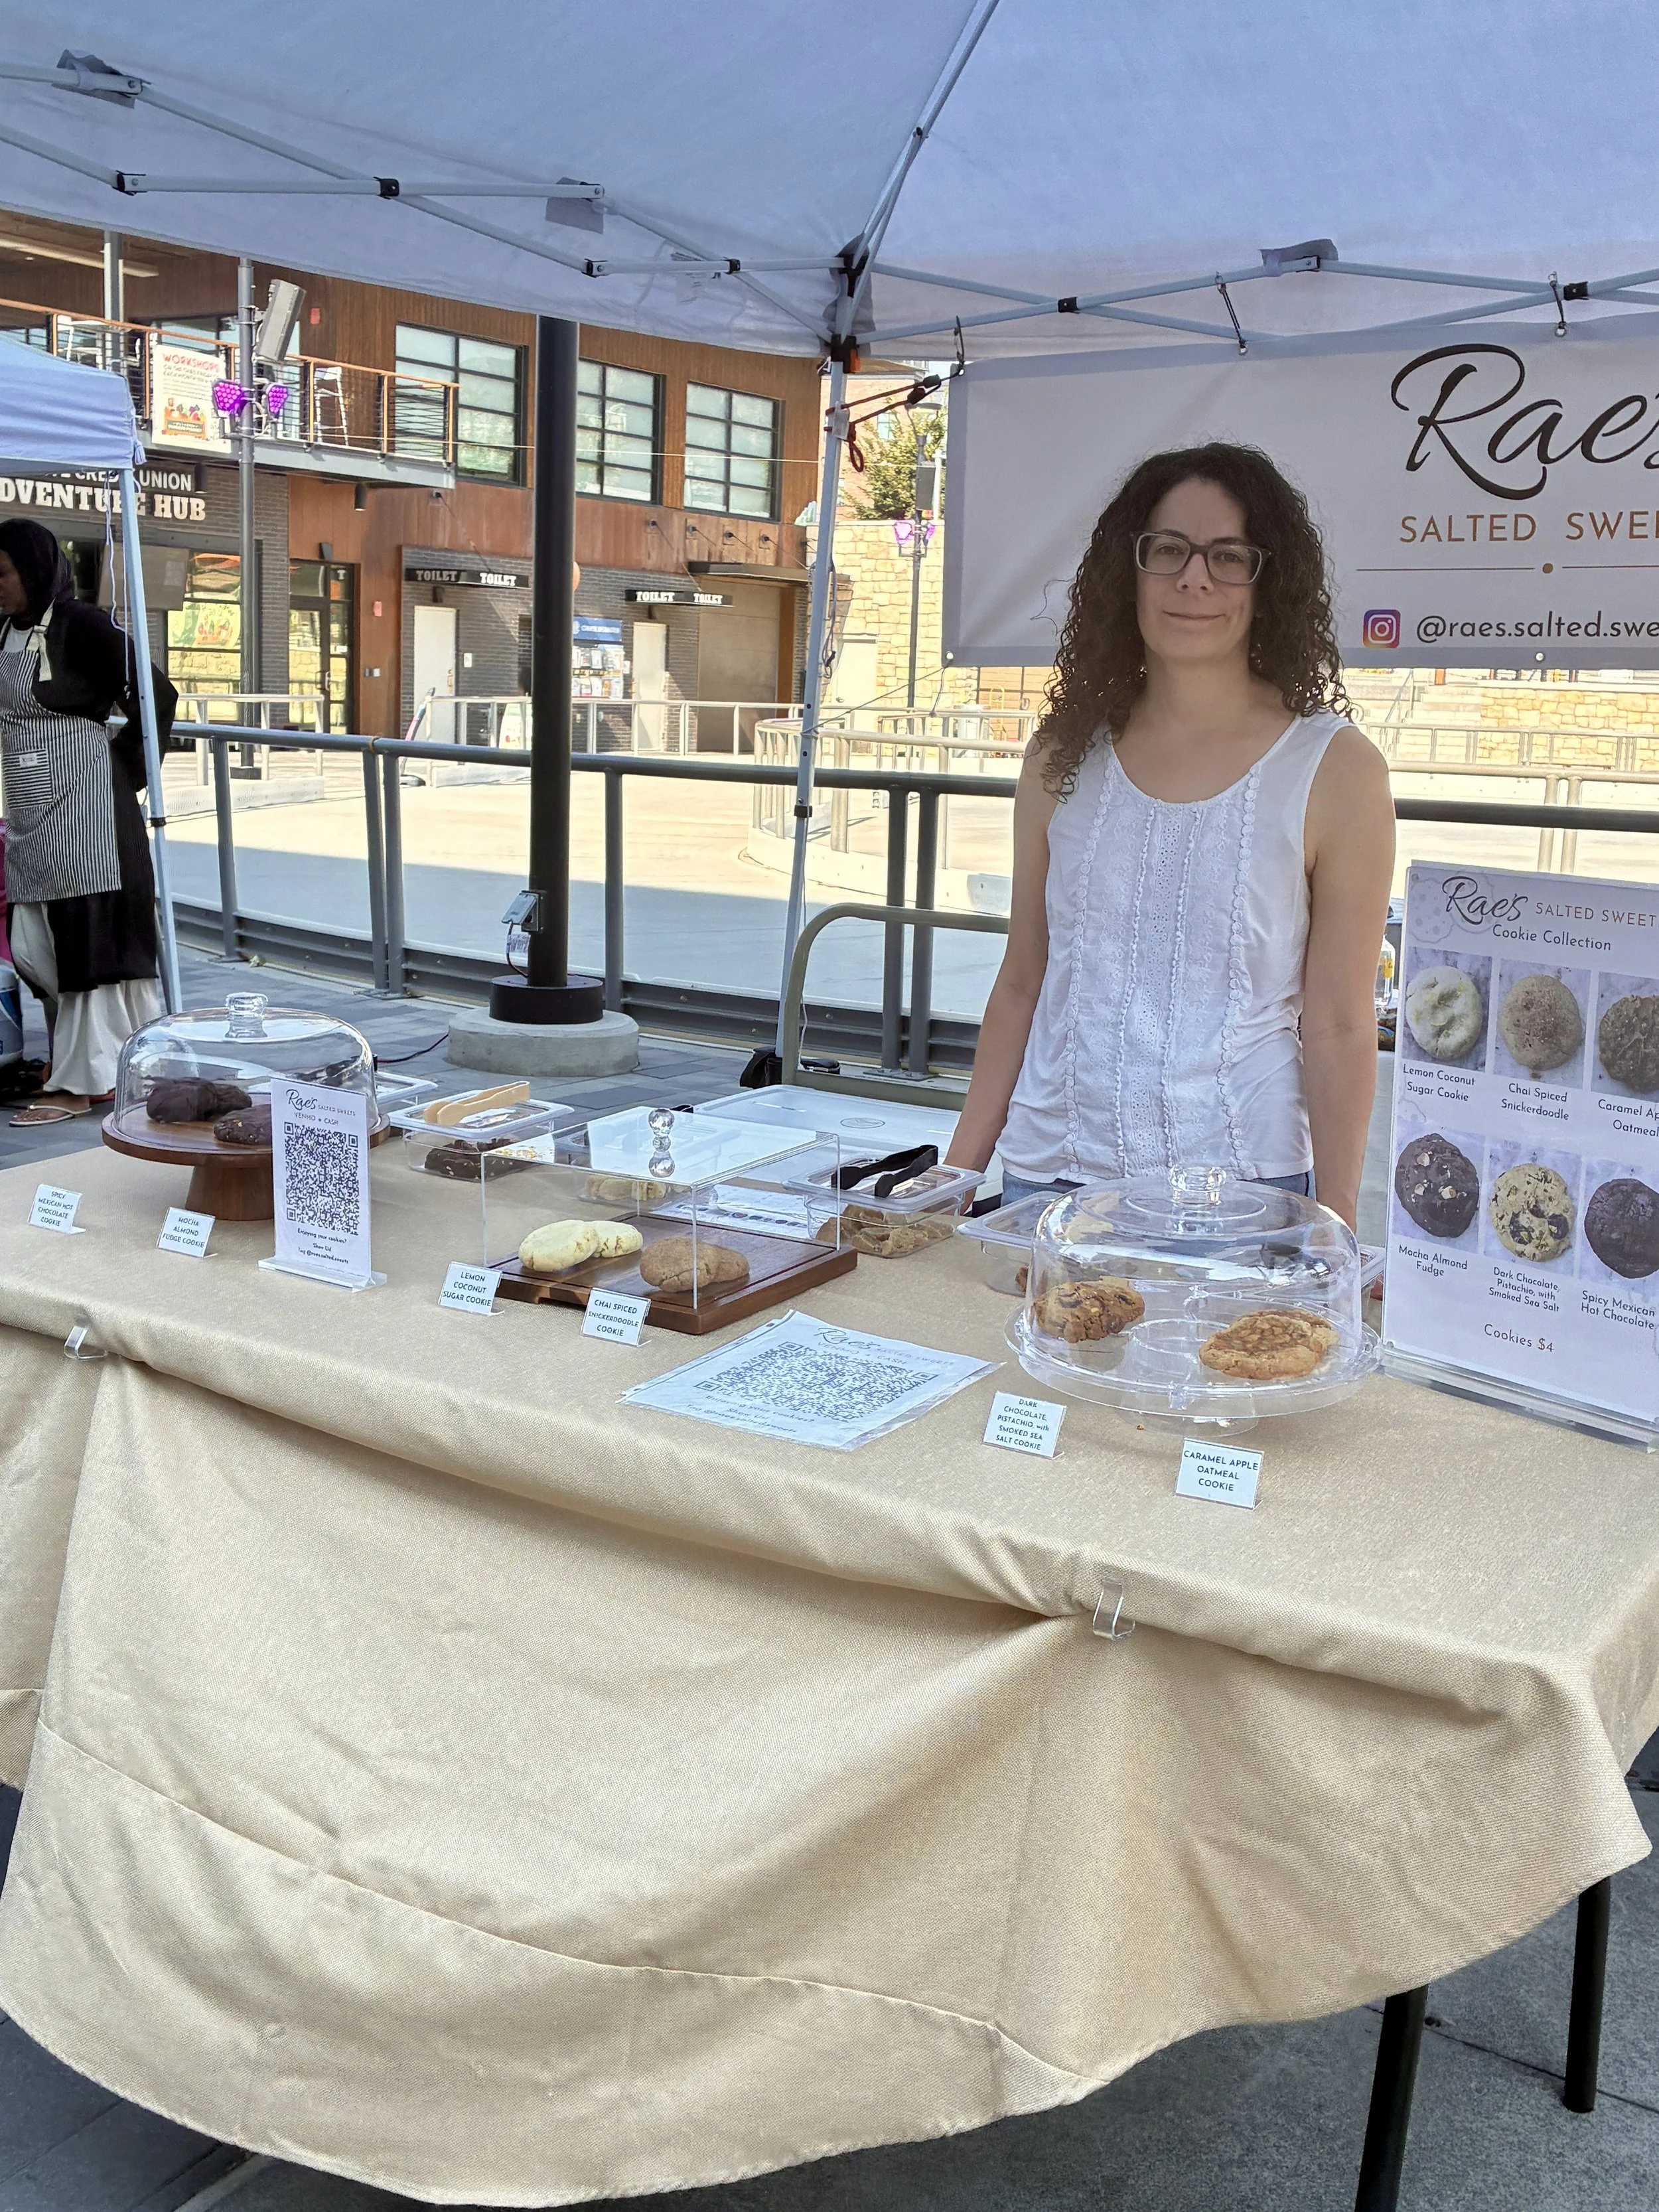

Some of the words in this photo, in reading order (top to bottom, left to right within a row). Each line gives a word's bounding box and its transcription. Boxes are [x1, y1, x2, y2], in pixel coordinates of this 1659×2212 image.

[139, 469, 191, 491] UNION
[153, 494, 206, 521] HUB
[1399, 514, 1537, 543] SALTED
[1565, 510, 1659, 540] SWE
[415, 570, 457, 581] TOILET
[479, 572, 517, 587] TOILET
[636, 591, 675, 602] TOILET
[693, 593, 723, 605] TOILET
[1416, 610, 1659, 643] @raes.salted.swe
[1442, 876, 1528, 925] Rae's
[1536, 902, 1594, 920] SALTED
[1601, 909, 1659, 927] SWEET
[1493, 924, 1537, 941] Cookie
[1543, 930, 1611, 951] Collection
[1404, 1063, 1434, 1078] Lemon
[1437, 1070, 1475, 1086] Coconut
[285, 1088, 318, 1111] Rae's
[1407, 1081, 1434, 1095] Sugar
[1437, 1087, 1469, 1101] Cookie
[1508, 1083, 1530, 1096] Chai
[1534, 1087, 1567, 1102] Spiced
[1501, 1098, 1569, 1120] Snickerdoodle
[1598, 1099, 1642, 1116] Caramel
[295, 1112, 316, 1121] VENMO
[1613, 1120, 1659, 1137] Oatmeal
[38, 1197, 62, 1207] MEXICAN
[38, 1207, 68, 1219] CHOCOLATE
[40, 1216, 61, 1226] COOKIE
[179, 1217, 199, 1226] MOCHA
[173, 1226, 199, 1236] ALMOND
[162, 1232, 182, 1242] FUDGE
[182, 1238, 205, 1248] COOKIE
[1399, 1245, 1429, 1260] Mocha
[1432, 1253, 1467, 1270] Almond
[461, 1272, 486, 1282] LEMON
[1417, 1260, 1444, 1277] Fudge
[453, 1282, 487, 1293] COCONUT
[1494, 1266, 1514, 1280] Dark
[1516, 1273, 1560, 1292] Chocolate,
[1497, 1278, 1536, 1296] Pistachio,
[1538, 1291, 1555, 1301] with
[443, 1291, 465, 1301] SUGAR
[466, 1295, 492, 1307] COOKIE
[594, 1299, 611, 1309] CHAI
[613, 1303, 637, 1314] SPICED
[1488, 1287, 1522, 1302] Smoked
[1524, 1295, 1540, 1307] Sea
[1544, 1301, 1559, 1312] Salt
[1582, 1290, 1609, 1307] Spicy
[1613, 1297, 1655, 1317] Mexican
[588, 1311, 639, 1327] SNICKERDOODLE
[1581, 1302, 1599, 1315] Hot
[1603, 1308, 1654, 1330] Chocolate
[597, 1325, 624, 1337] COOKIE
[1484, 1323, 1532, 1347] Cookies
[1538, 1337, 1554, 1352] $4
[818, 1341, 859, 1355] VENMO
[877, 1355, 908, 1364] CASH
[1019, 1398, 1038, 1408] DARK
[997, 1414, 1035, 1428] PISTACHIO,
[998, 1425, 1029, 1437] SMOKED
[995, 1435, 1013, 1443] SALT
[1014, 1439, 1041, 1450] COOKIE
[1184, 1450, 1227, 1465] CARAMEL
[1229, 1459, 1259, 1471] APPLE
[1197, 1465, 1240, 1480] OATMEAL
[1198, 1478, 1234, 1491] COOKIE
